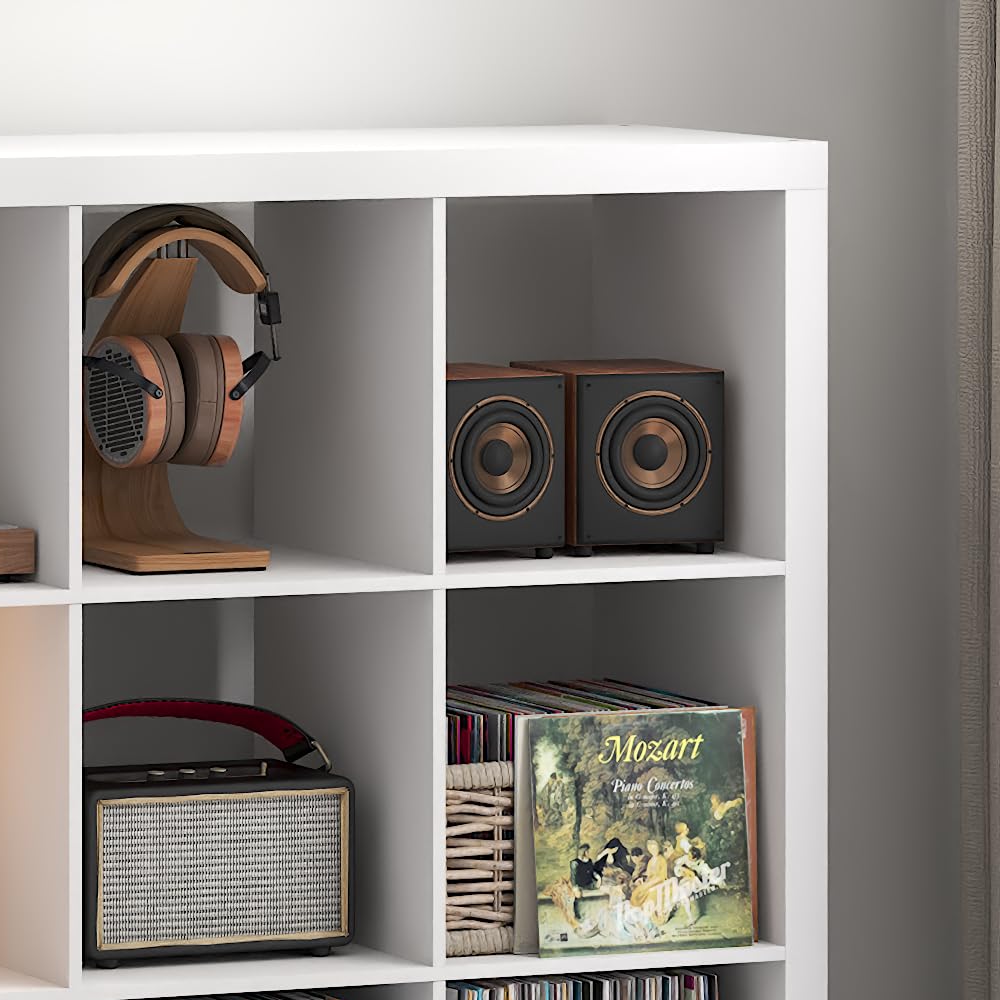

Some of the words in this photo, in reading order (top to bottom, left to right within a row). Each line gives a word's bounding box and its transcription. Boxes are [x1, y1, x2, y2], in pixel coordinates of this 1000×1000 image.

[598, 734, 704, 764] Mozart
[611, 778, 643, 793] Piano
[647, 776, 695, 794] Concertos
